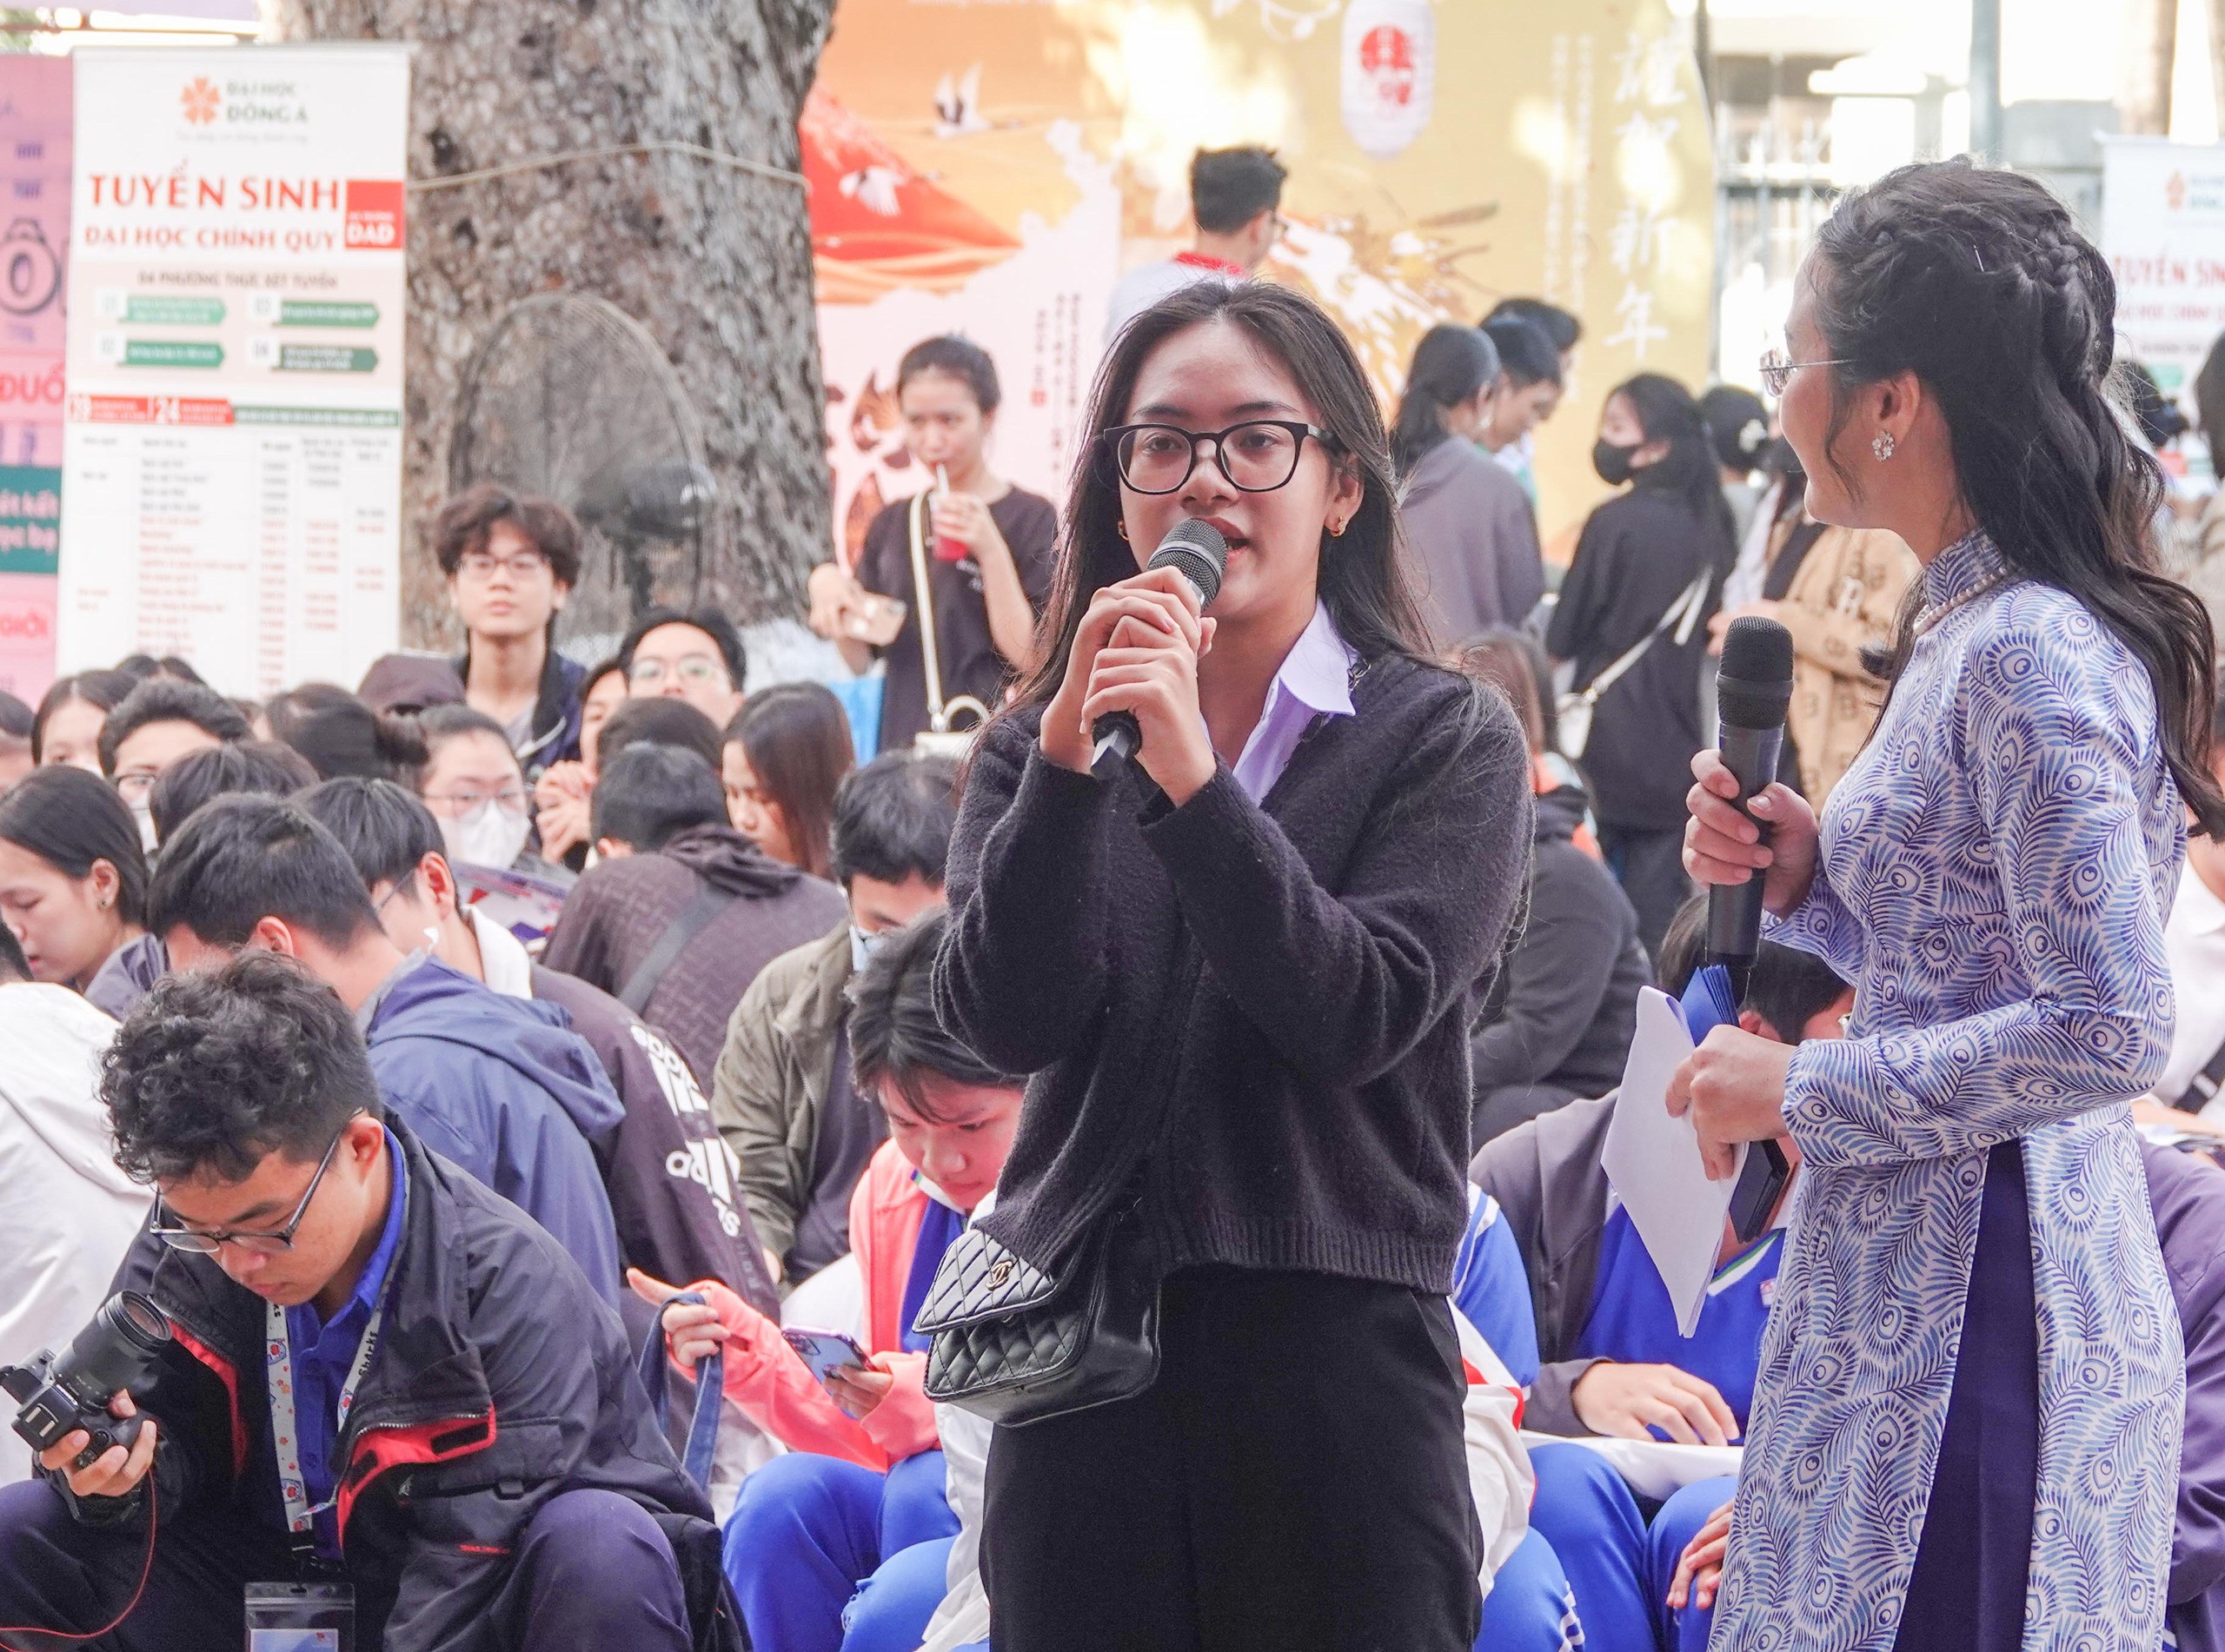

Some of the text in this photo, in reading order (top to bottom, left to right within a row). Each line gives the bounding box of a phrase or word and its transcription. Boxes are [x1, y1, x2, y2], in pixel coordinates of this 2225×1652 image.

[90, 156, 225, 209] TUYỂN
[240, 176, 339, 211] SINH
[285, 229, 336, 255] QUY
